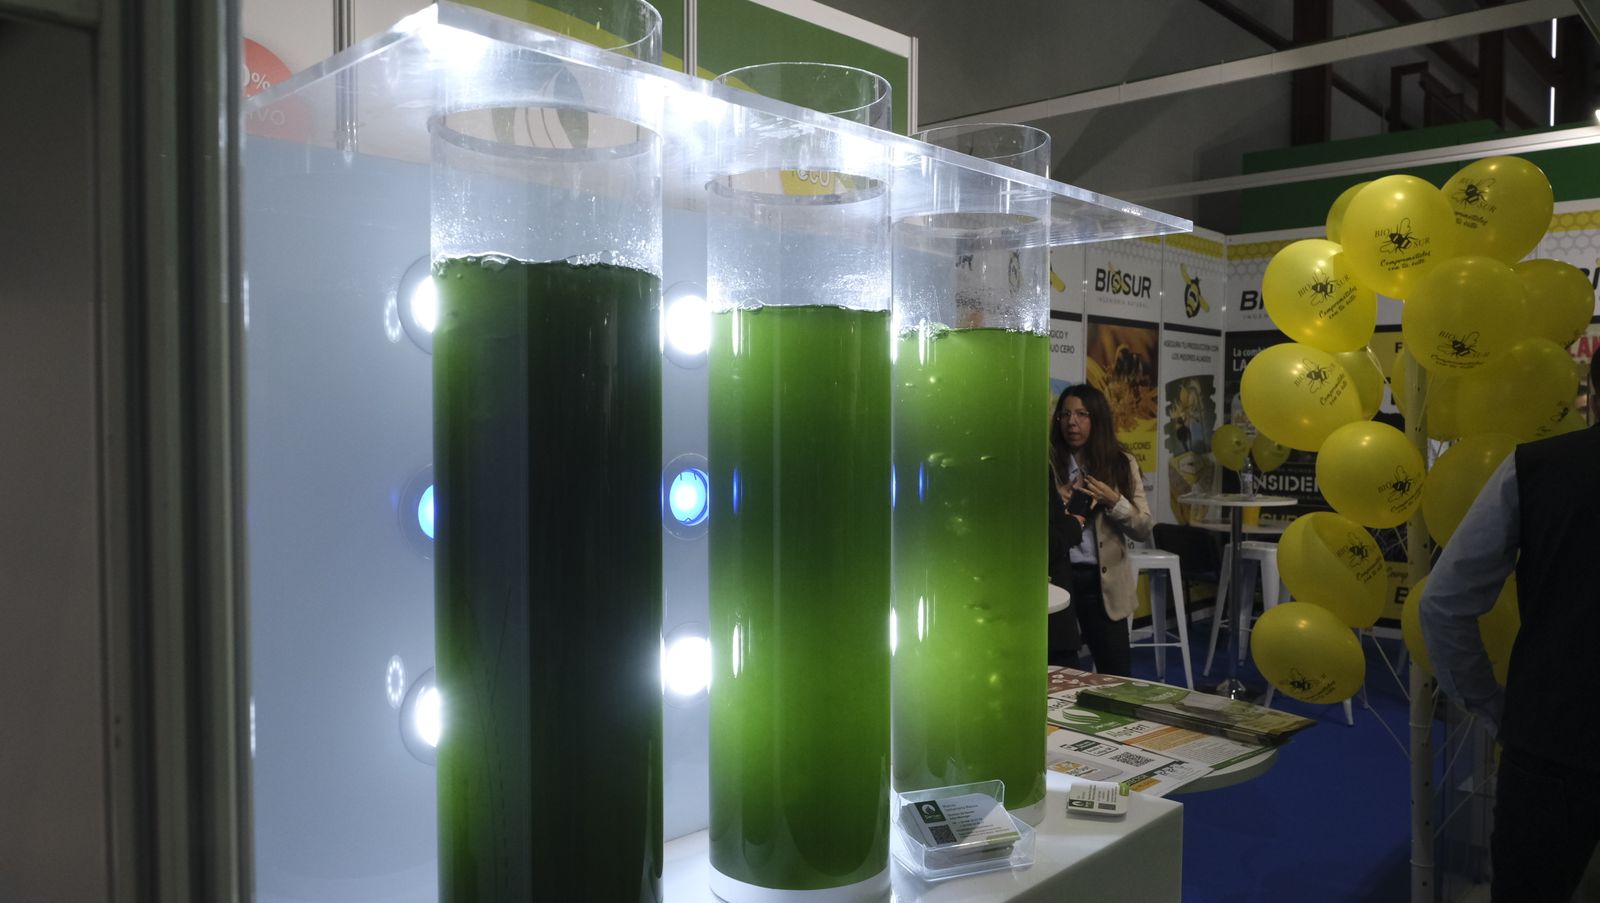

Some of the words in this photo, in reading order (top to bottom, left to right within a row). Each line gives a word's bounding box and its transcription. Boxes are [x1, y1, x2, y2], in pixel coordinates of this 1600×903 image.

[1095, 267, 1152, 299] BIOSUR
[1060, 344, 1075, 354] CERO
[1233, 347, 1242, 357] La
